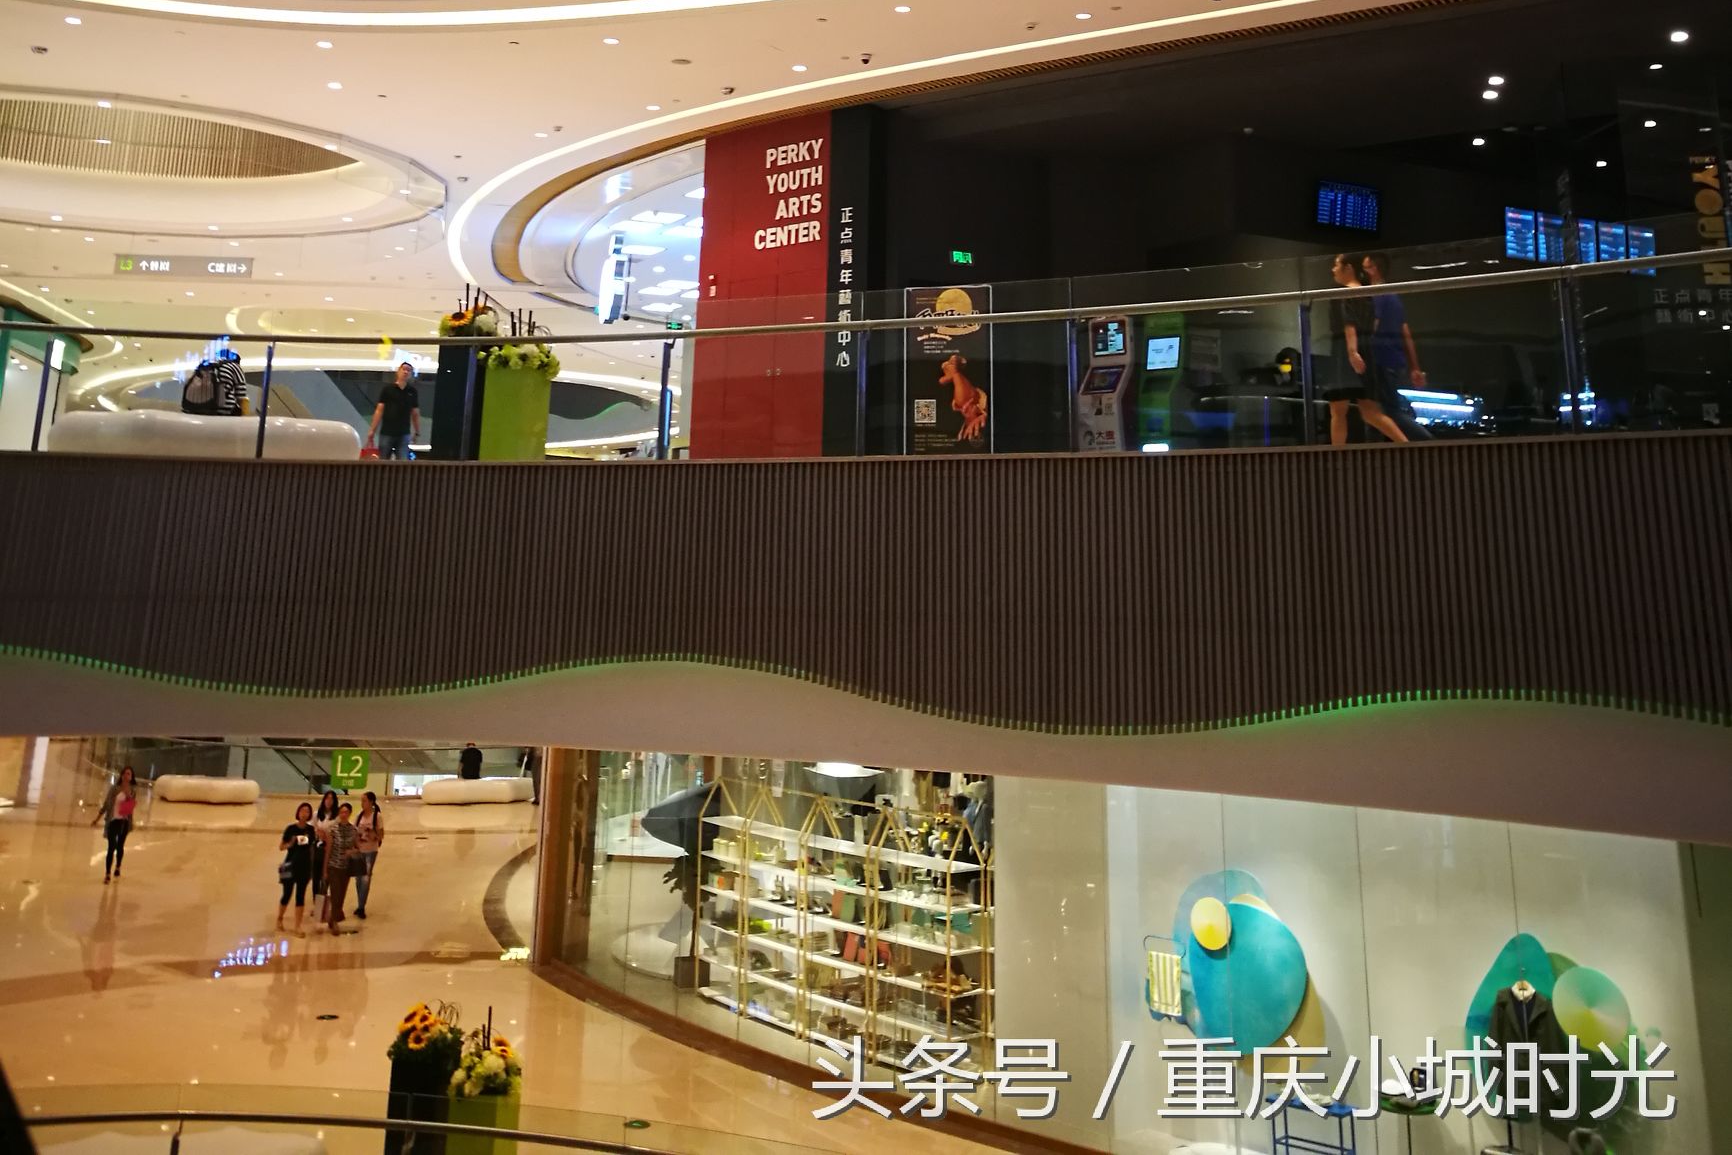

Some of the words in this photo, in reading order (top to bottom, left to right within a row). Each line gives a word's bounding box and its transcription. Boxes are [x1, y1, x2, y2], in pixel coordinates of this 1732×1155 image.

[766, 139, 823, 169] PERKY
[766, 165, 823, 195] YOUTH
[775, 192, 822, 221] ARTS
[754, 220, 821, 251] CENTER
[336, 755, 363, 777] L2
